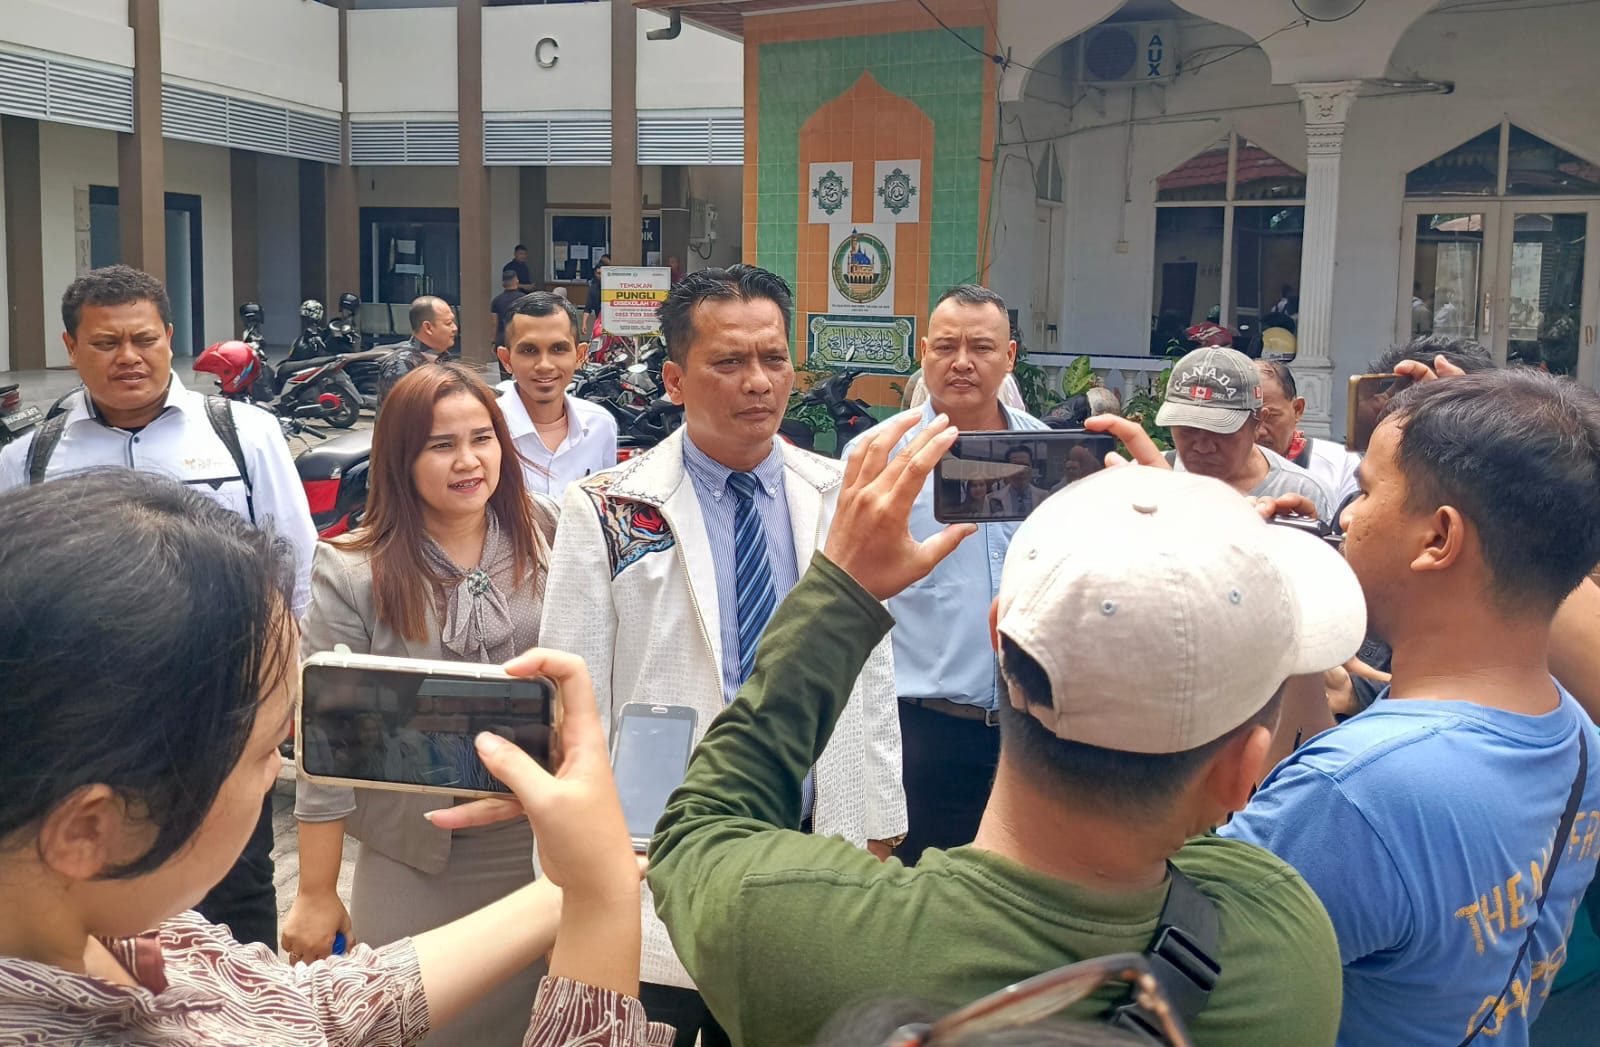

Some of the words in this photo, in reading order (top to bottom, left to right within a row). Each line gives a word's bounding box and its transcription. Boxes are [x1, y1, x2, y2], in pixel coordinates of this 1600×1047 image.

[535, 37, 559, 69] C
[1148, 34, 1162, 77] AUX
[616, 291, 656, 300] PUNGLI
[1174, 366, 1237, 399] CANADA
[1454, 871, 1528, 956] THE
